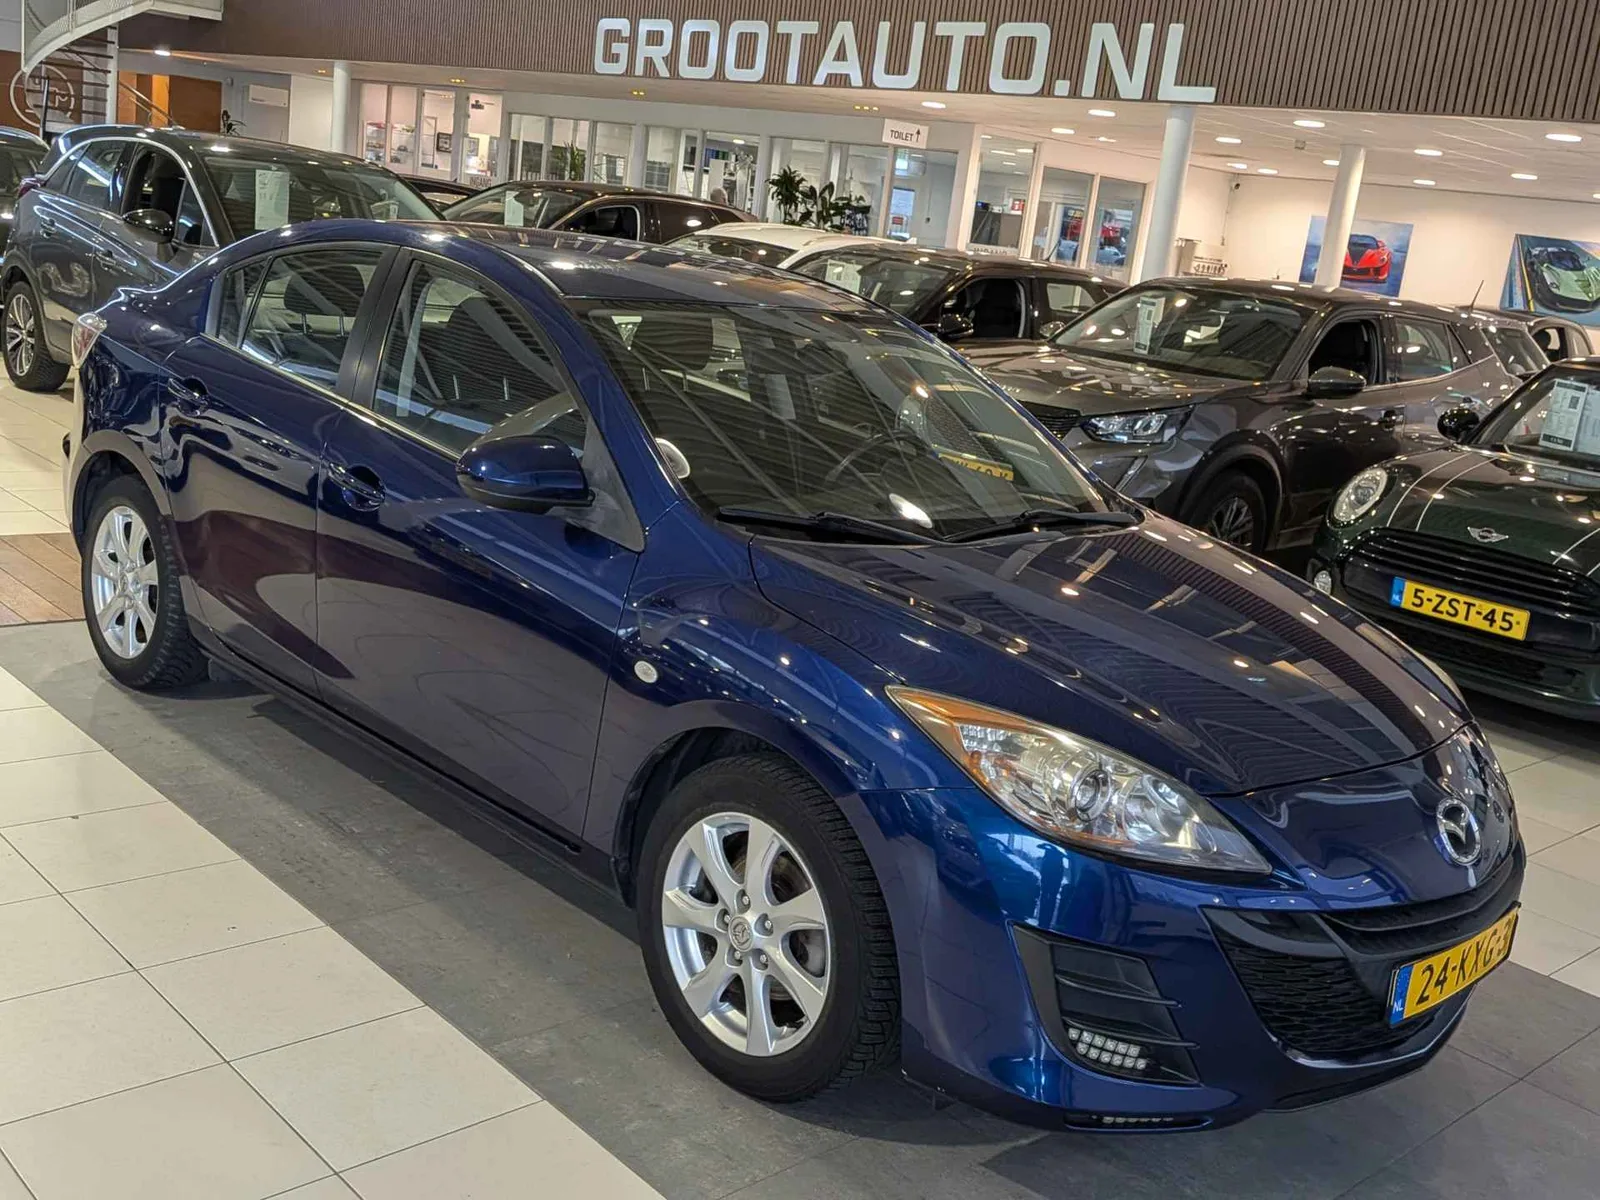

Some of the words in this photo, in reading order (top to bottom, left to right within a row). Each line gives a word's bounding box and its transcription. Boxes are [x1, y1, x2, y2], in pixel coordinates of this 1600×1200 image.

[594, 18, 1217, 103] GROOTAUTO.NL
[889, 129, 914, 142] TOILET
[1411, 588, 1514, 632] 5-ZST-45
[1392, 999, 1404, 1014] NL
